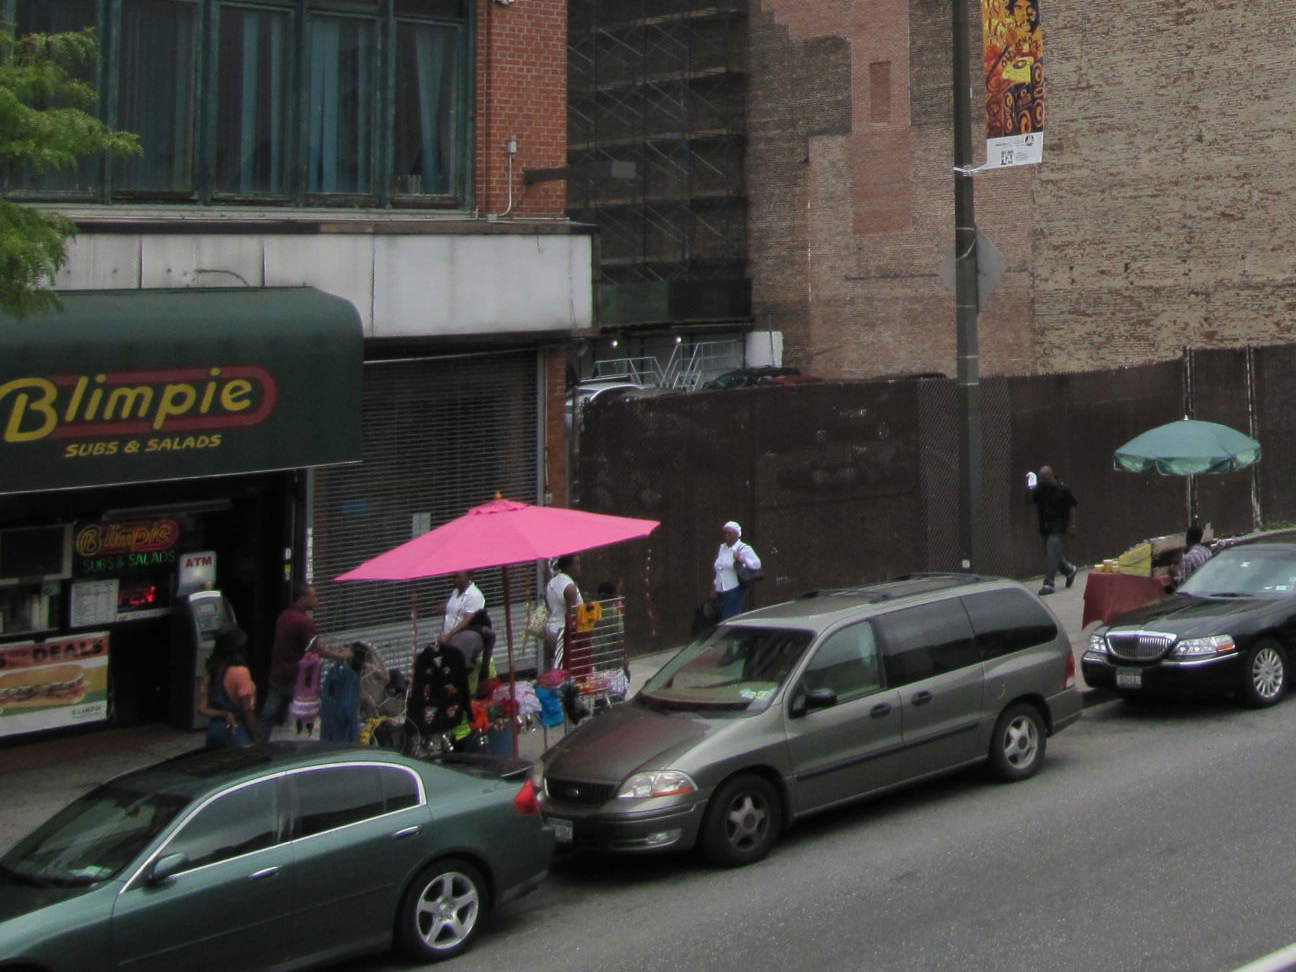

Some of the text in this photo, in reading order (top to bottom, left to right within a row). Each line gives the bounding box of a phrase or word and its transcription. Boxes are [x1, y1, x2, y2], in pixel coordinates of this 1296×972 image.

[0, 367, 253, 443] Blimpie
[64, 434, 223, 458] SUBS & SALADS
[76, 520, 172, 555] Blimpie
[82, 556, 115, 573] SUBS
[127, 549, 177, 567] SALADS
[185, 555, 214, 569] ATM
[33, 639, 105, 663] DEALS
